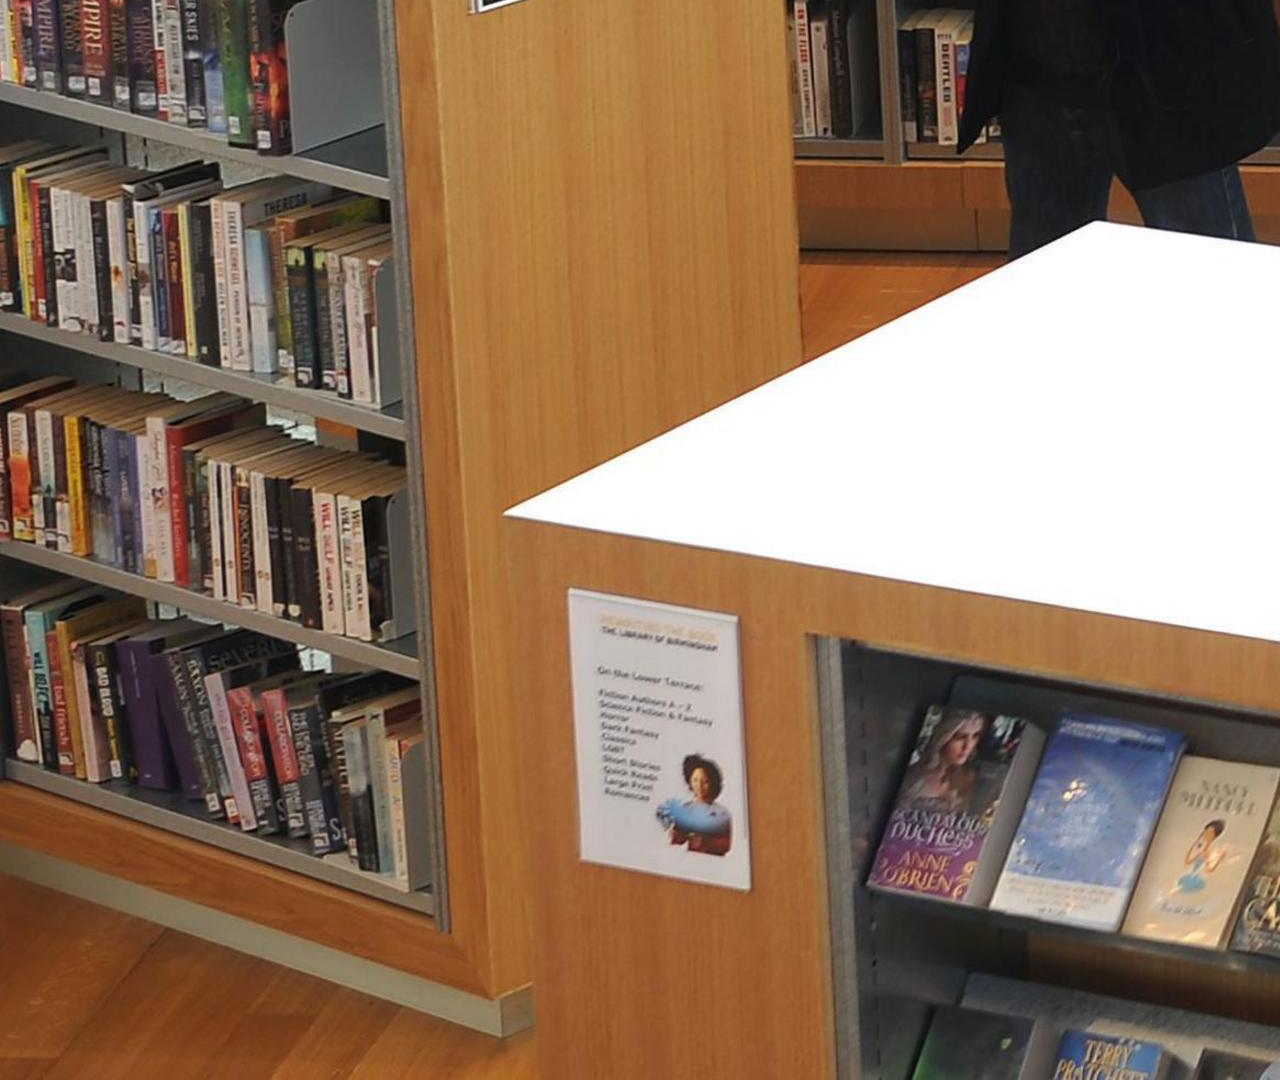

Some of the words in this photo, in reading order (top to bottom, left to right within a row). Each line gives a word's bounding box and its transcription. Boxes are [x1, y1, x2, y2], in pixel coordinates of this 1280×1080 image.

[185, 11, 199, 41] SKIES
[95, 666, 112, 691] BAD
[899, 850, 953, 873] ANNE
